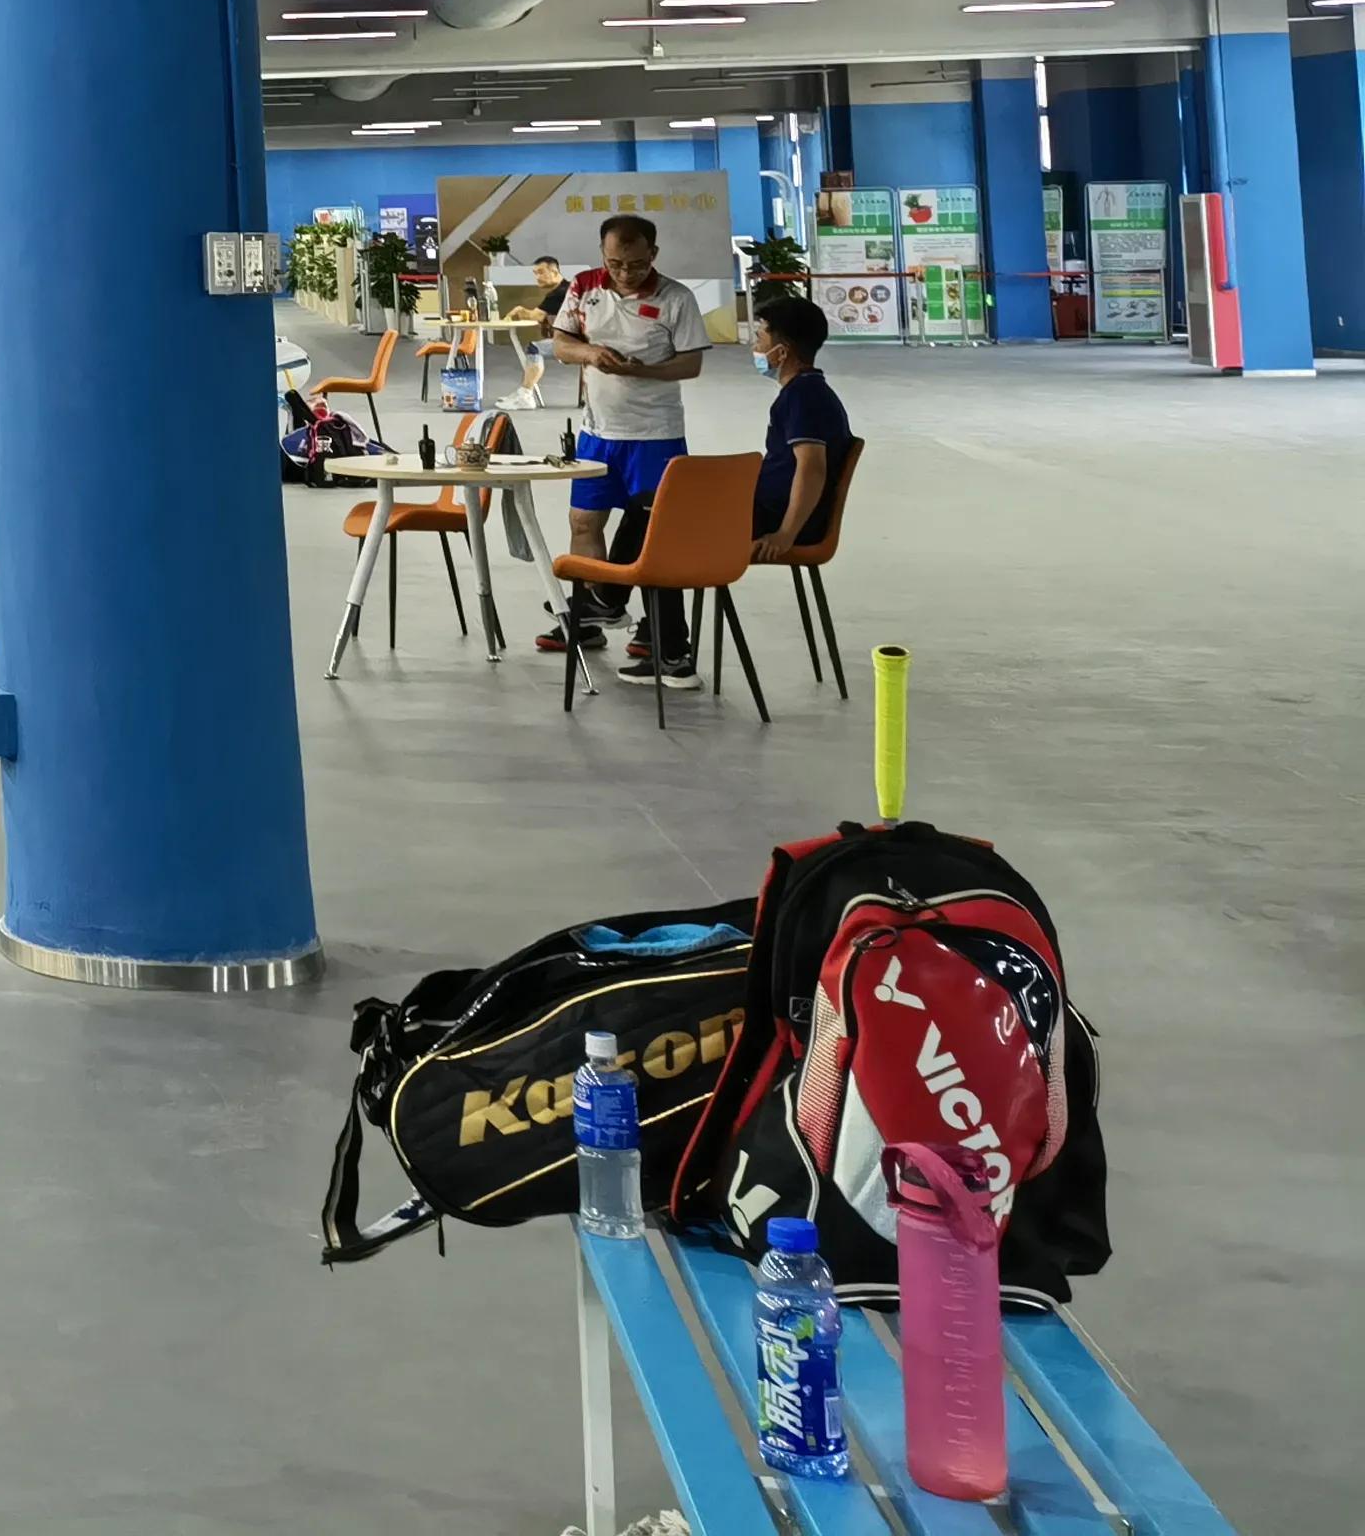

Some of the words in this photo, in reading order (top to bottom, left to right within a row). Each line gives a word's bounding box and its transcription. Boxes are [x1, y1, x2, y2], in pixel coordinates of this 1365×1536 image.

[459, 1007, 746, 1148] Kaon
[915, 1020, 1016, 1228] VICTOR
[756, 1316, 810, 1440] 脉动
